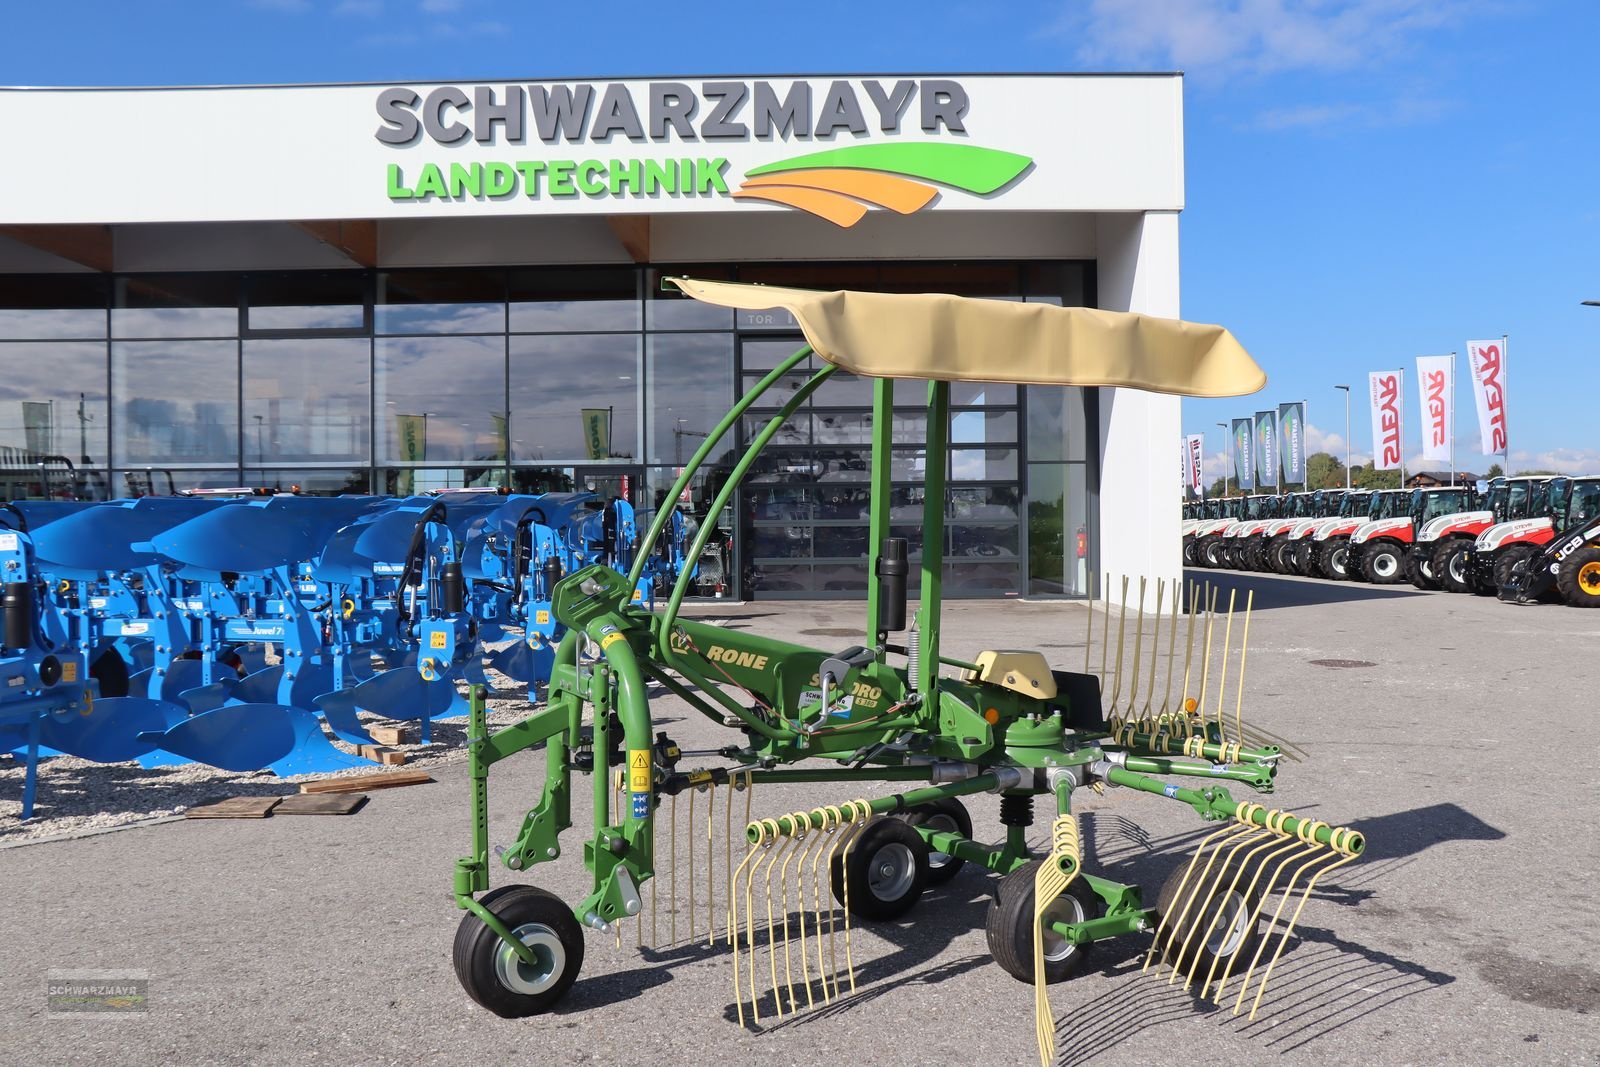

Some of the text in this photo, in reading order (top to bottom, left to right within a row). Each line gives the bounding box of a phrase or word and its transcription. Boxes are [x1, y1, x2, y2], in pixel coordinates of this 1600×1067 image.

[375, 79, 968, 142] SCHWARZMAYR
[387, 158, 731, 198] LANDTECHNIK
[747, 314, 773, 324] TOR
[1556, 536, 1584, 561] JCB
